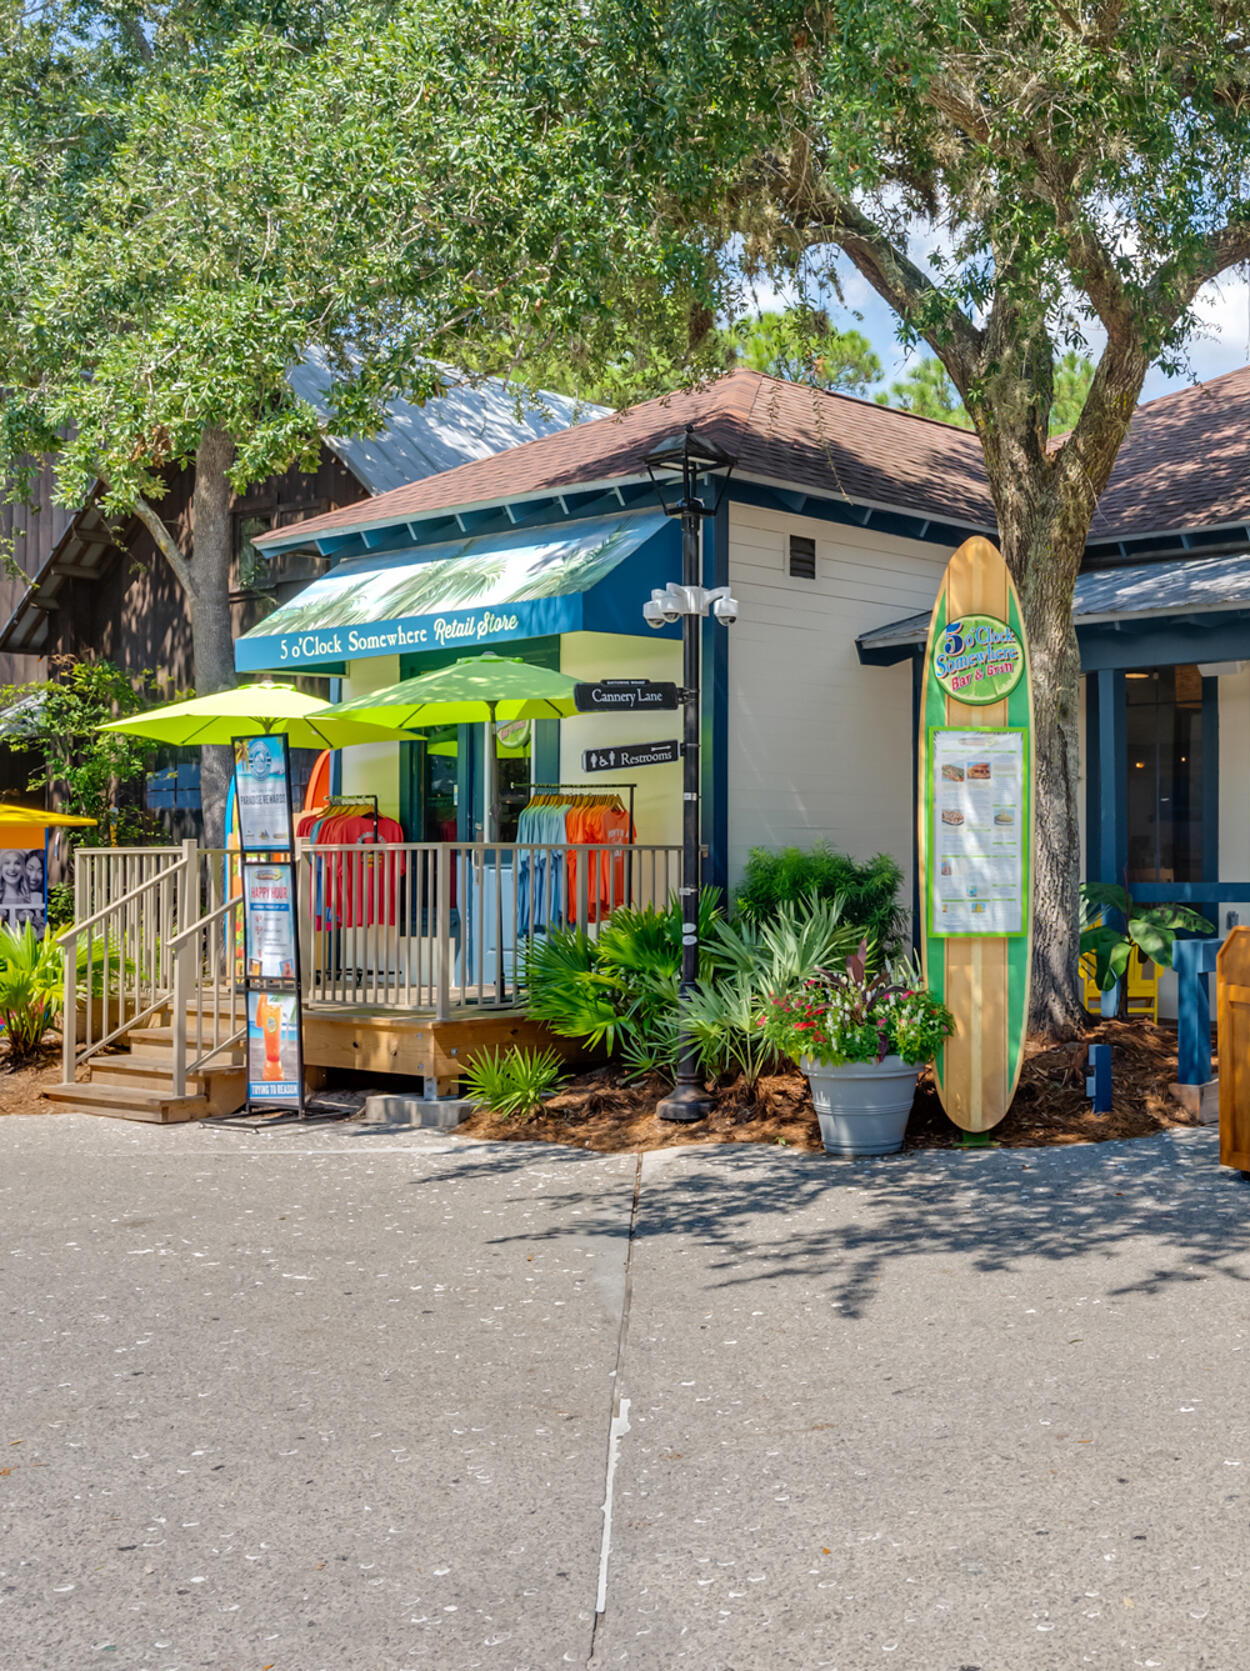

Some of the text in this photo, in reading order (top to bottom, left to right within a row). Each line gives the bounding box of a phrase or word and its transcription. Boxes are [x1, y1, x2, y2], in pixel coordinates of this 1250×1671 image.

[280, 610, 519, 660] 5 o'Clock Somewhere Retail Store
[945, 622, 1016, 655] 5 o'Clock
[936, 645, 1018, 678] Somewhere
[951, 662, 1013, 691] Bar & Grill
[591, 688, 663, 708] Cannery Lane
[620, 751, 672, 766] Restrooms
[251, 887, 288, 899] HAPPY HOUR
[252, 1085, 269, 1095] TRYING
